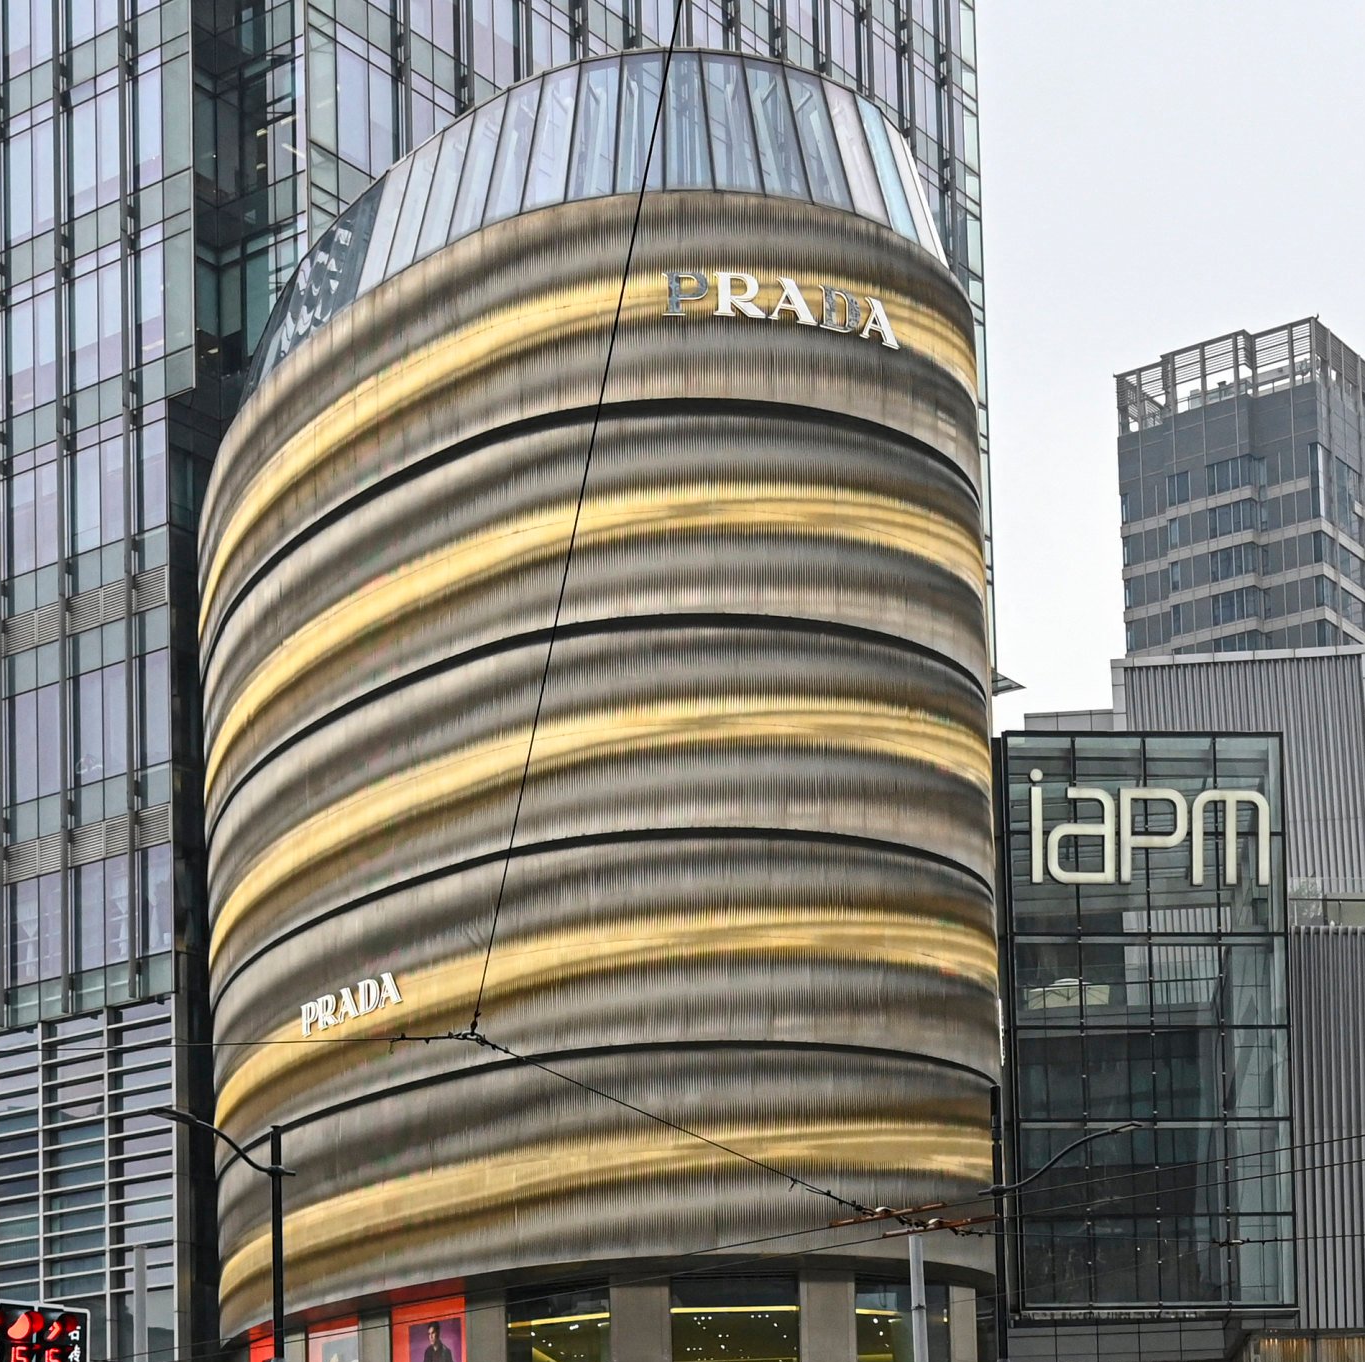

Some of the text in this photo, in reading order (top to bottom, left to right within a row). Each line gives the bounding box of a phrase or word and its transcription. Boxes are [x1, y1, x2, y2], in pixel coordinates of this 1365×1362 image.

[661, 271, 900, 350] PRADA
[1029, 768, 1270, 886] iapm
[300, 971, 404, 1037] PRADA
